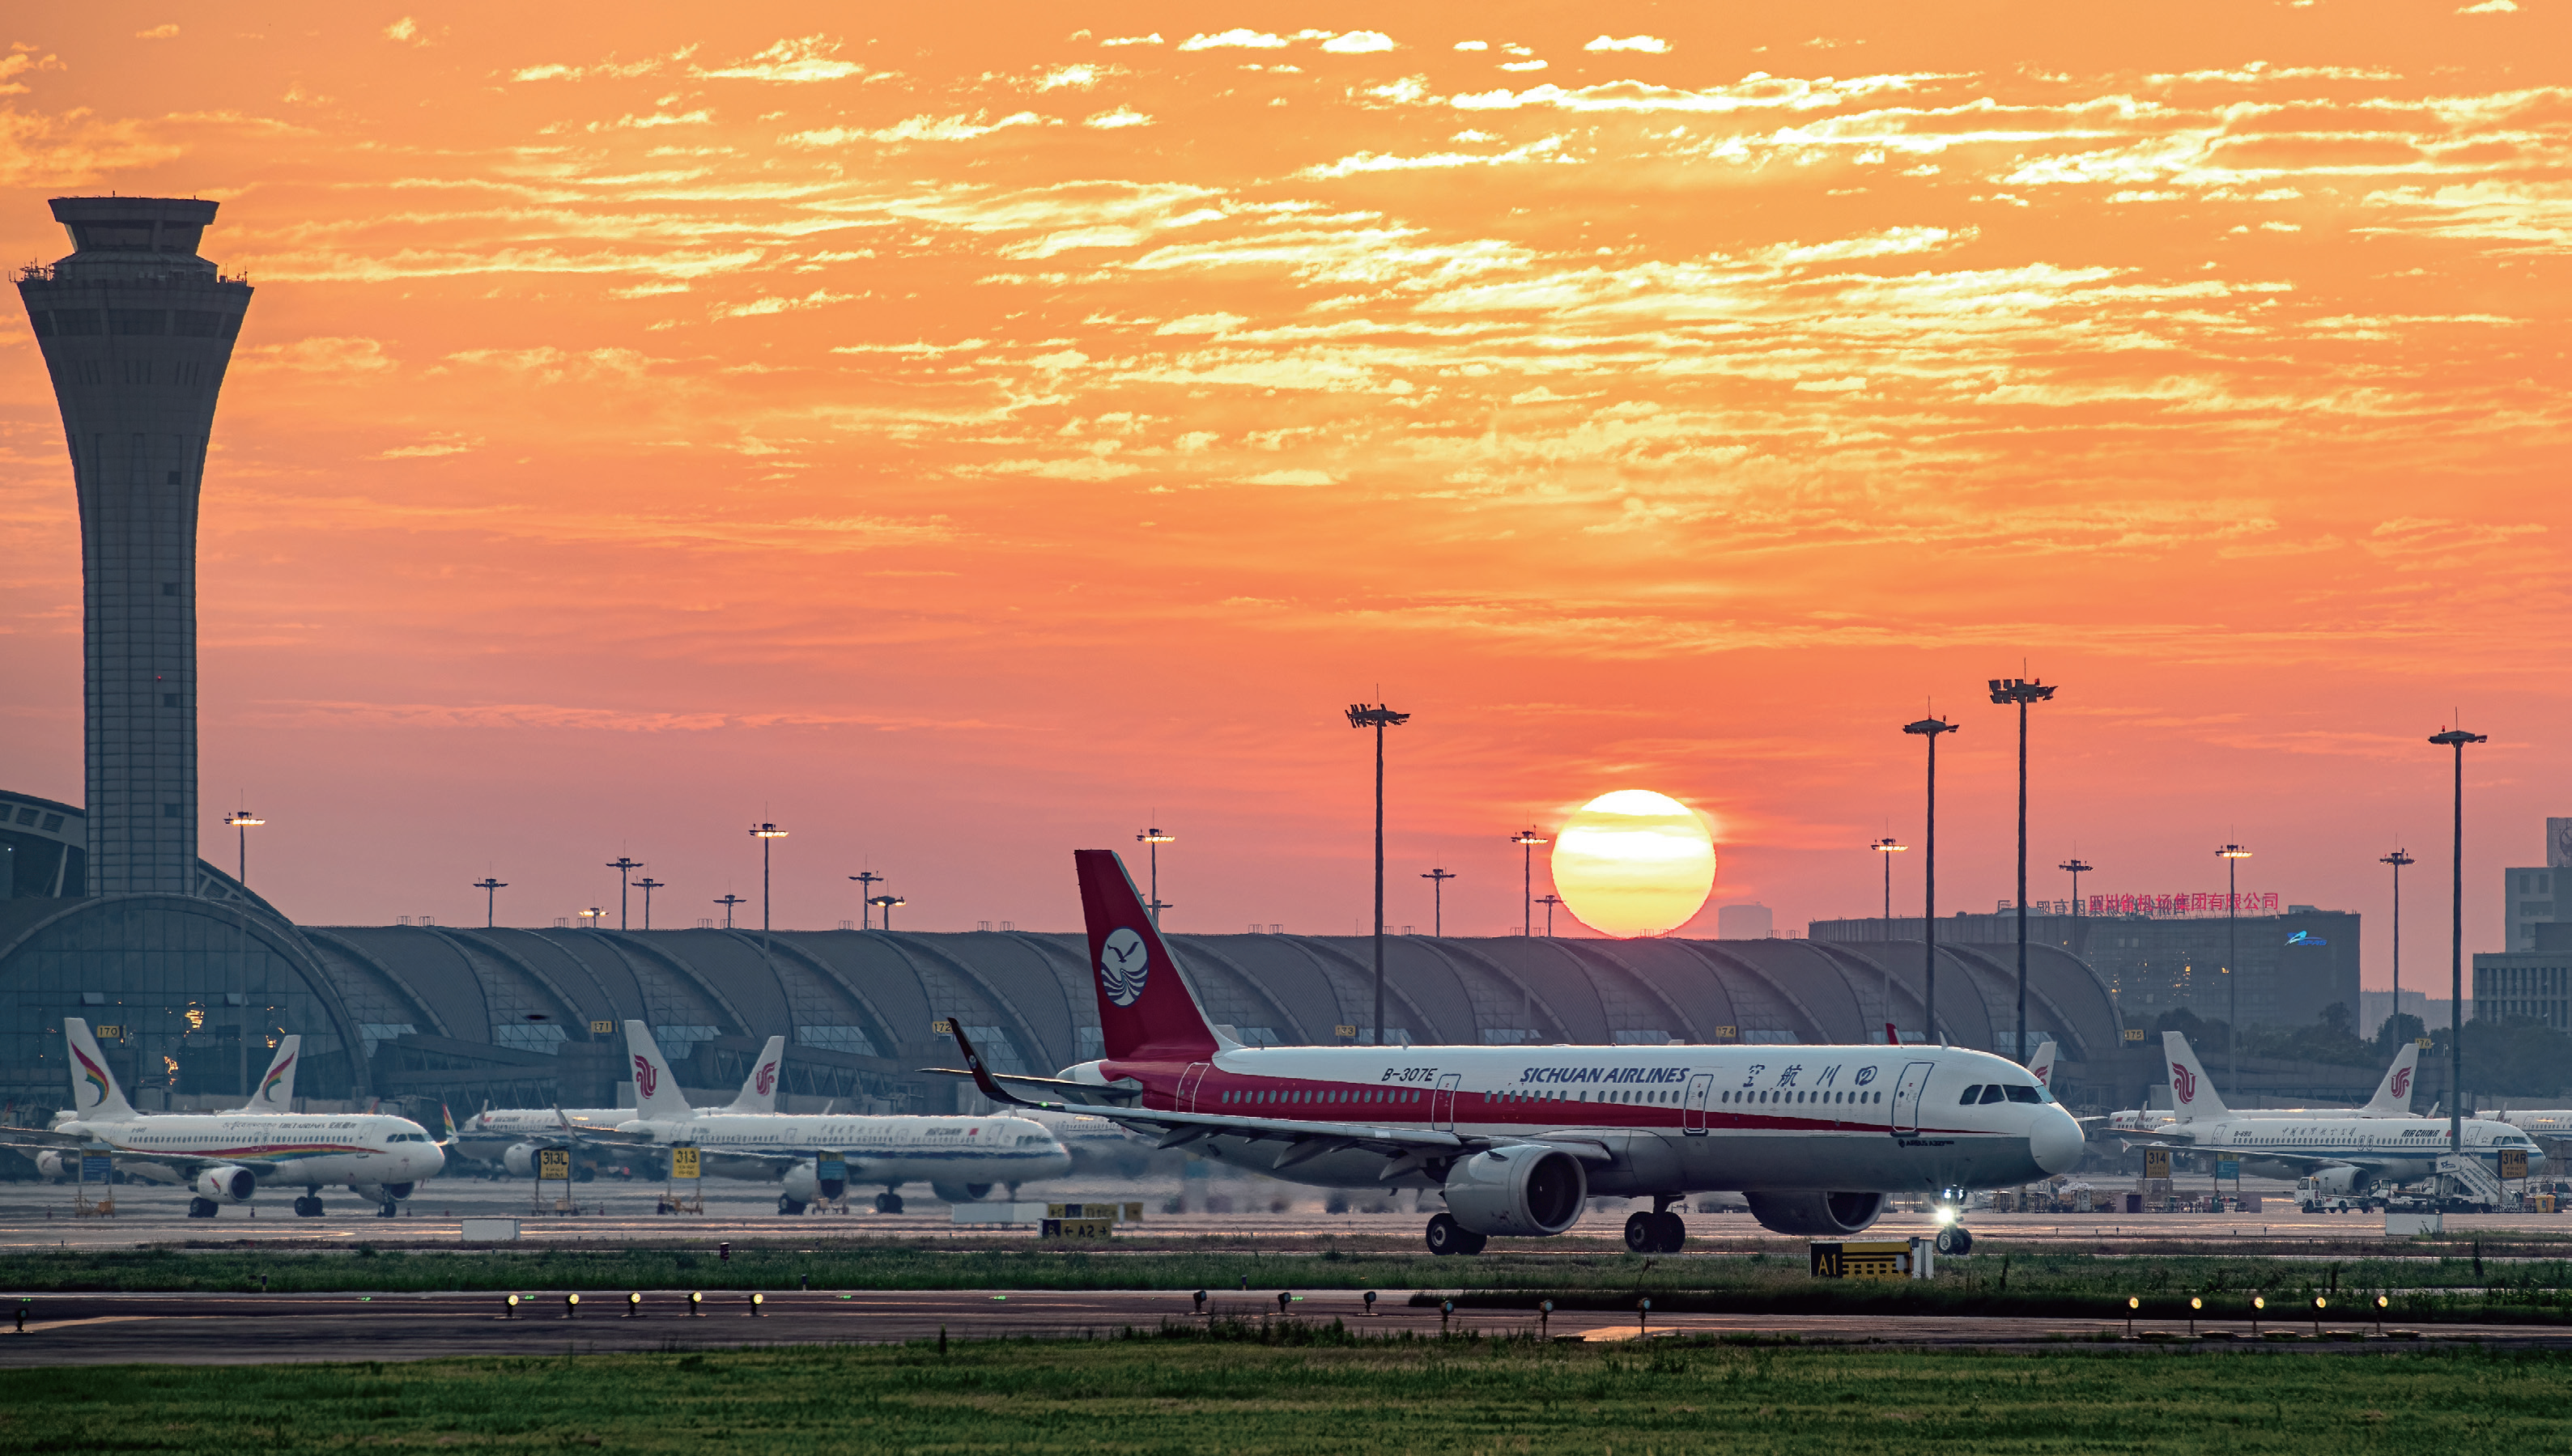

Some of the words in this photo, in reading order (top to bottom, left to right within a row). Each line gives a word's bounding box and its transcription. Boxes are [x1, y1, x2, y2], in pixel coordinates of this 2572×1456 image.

[2089, 892, 2279, 913] 四川省机场集团有限公司
[100, 1027, 117, 1036] 170
[934, 1023, 951, 1033] 172
[2126, 1030, 2142, 1039] 175
[1381, 1068, 1438, 1082] B-307E
[1520, 1067, 1605, 1083] SICHUAN
[1602, 1067, 1690, 1083] AIRLINES
[2401, 1129, 2417, 1138] AIR
[2415, 1129, 2441, 1138] CHINA
[543, 1152, 568, 1165] 313L
[676, 1150, 697, 1164] 313
[2149, 1152, 2166, 1165] 314
[2502, 1152, 2527, 1165] 314R
[1078, 1225, 1095, 1238] A2
[1818, 1254, 1837, 1276] A1
